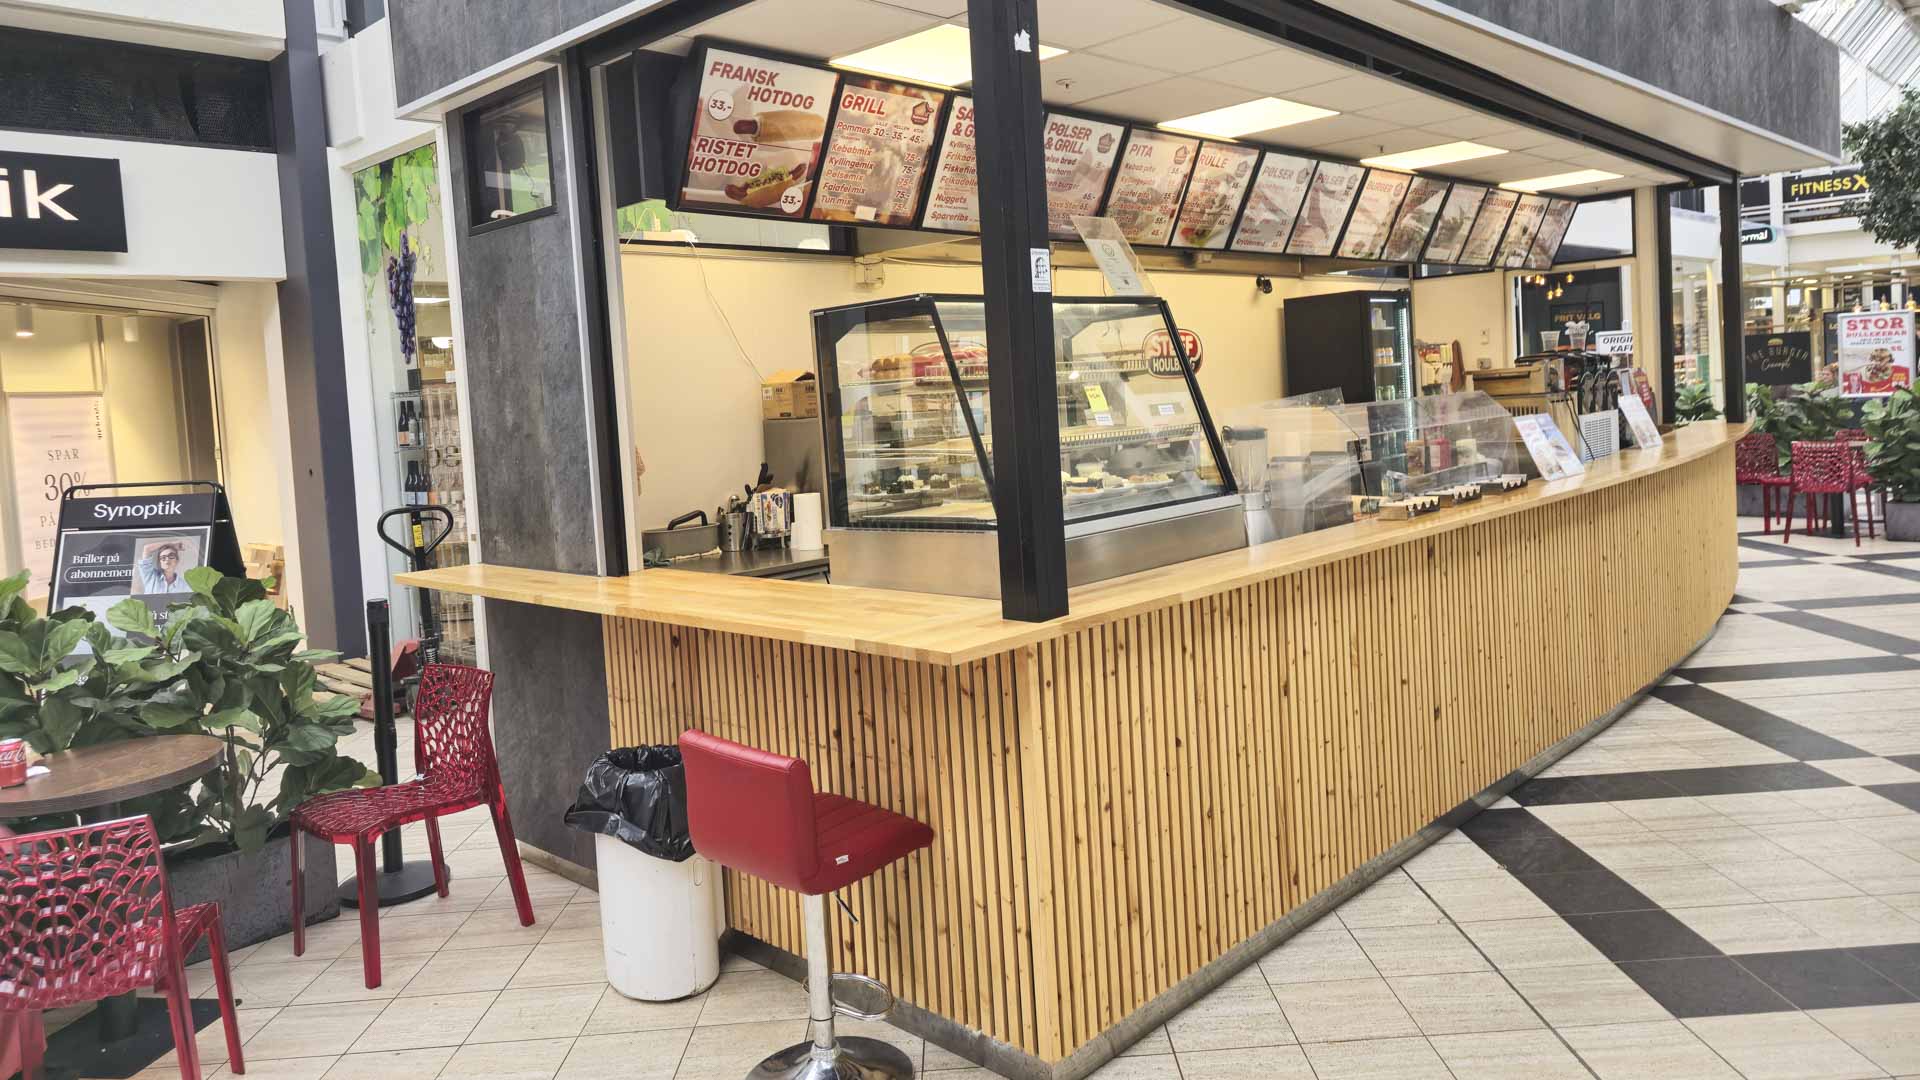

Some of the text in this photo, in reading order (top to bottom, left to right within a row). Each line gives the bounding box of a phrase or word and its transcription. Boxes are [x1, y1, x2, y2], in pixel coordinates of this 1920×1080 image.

[709, 61, 780, 87] FRANSK
[748, 85, 814, 110] HOTDOG
[841, 93, 886, 116] GRILL
[710, 99, 732, 112] 33,-
[955, 106, 975, 121] SA
[836, 121, 871, 135] Pommes
[952, 122, 976, 138] & G
[1047, 121, 1093, 142] PØLSER
[695, 138, 757, 159] RISTET
[831, 143, 873, 157] Kebabmix
[1044, 136, 1084, 155] & GRILL
[1129, 144, 1153, 158] PITA
[691, 155, 762, 177] HOTDOG
[828, 156, 874, 170] Kyllingemix
[942, 163, 976, 175] Fiskefile
[1199, 154, 1229, 169] RULLE
[781, 195, 801, 206] 33,-
[935, 192, 967, 205] Nuggets
[930, 210, 969, 222] Spareribs
[1741, 229, 1768, 243] ormal
[1846, 316, 1904, 331] STOR
[1152, 335, 1194, 358] STEF
[1610, 345, 1632, 353] KAF
[1152, 356, 1196, 373] HOULB
[47, 448, 80, 462] SPAR
[44, 471, 90, 501] 30%
[94, 501, 182, 521] Synoptik
[72, 553, 120, 566] Briller på
[70, 567, 134, 579] abonnemen
